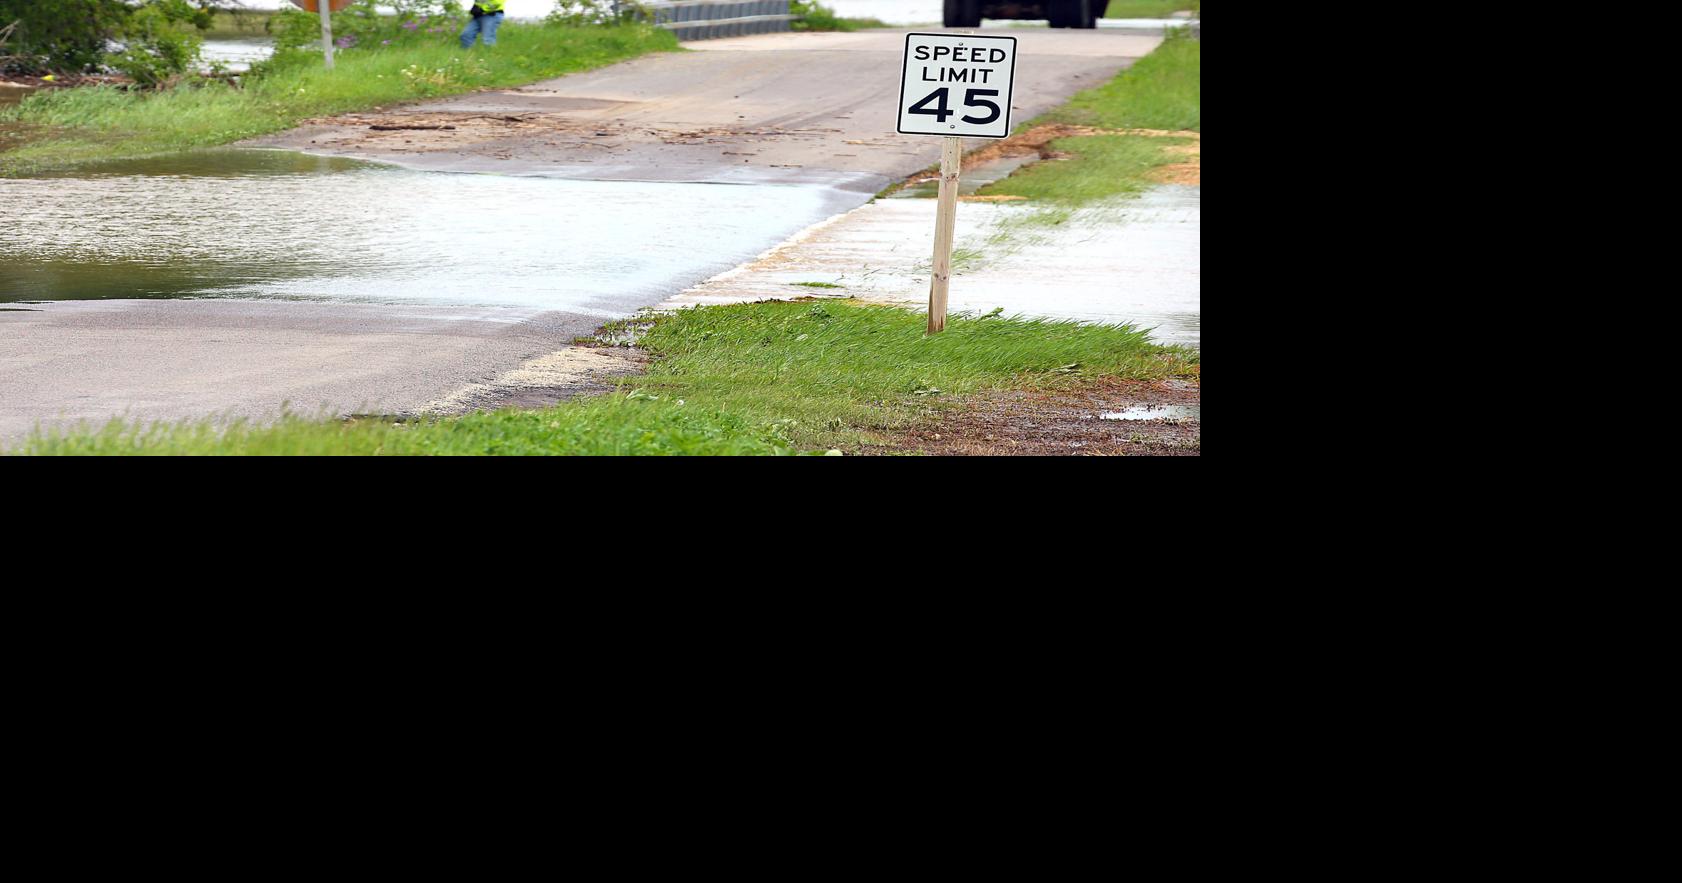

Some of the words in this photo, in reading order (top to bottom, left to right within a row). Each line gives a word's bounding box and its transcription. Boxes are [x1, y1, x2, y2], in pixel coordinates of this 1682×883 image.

[914, 45, 1006, 63] SPEED
[922, 66, 994, 84] LIMIT
[907, 87, 1001, 125] 45
